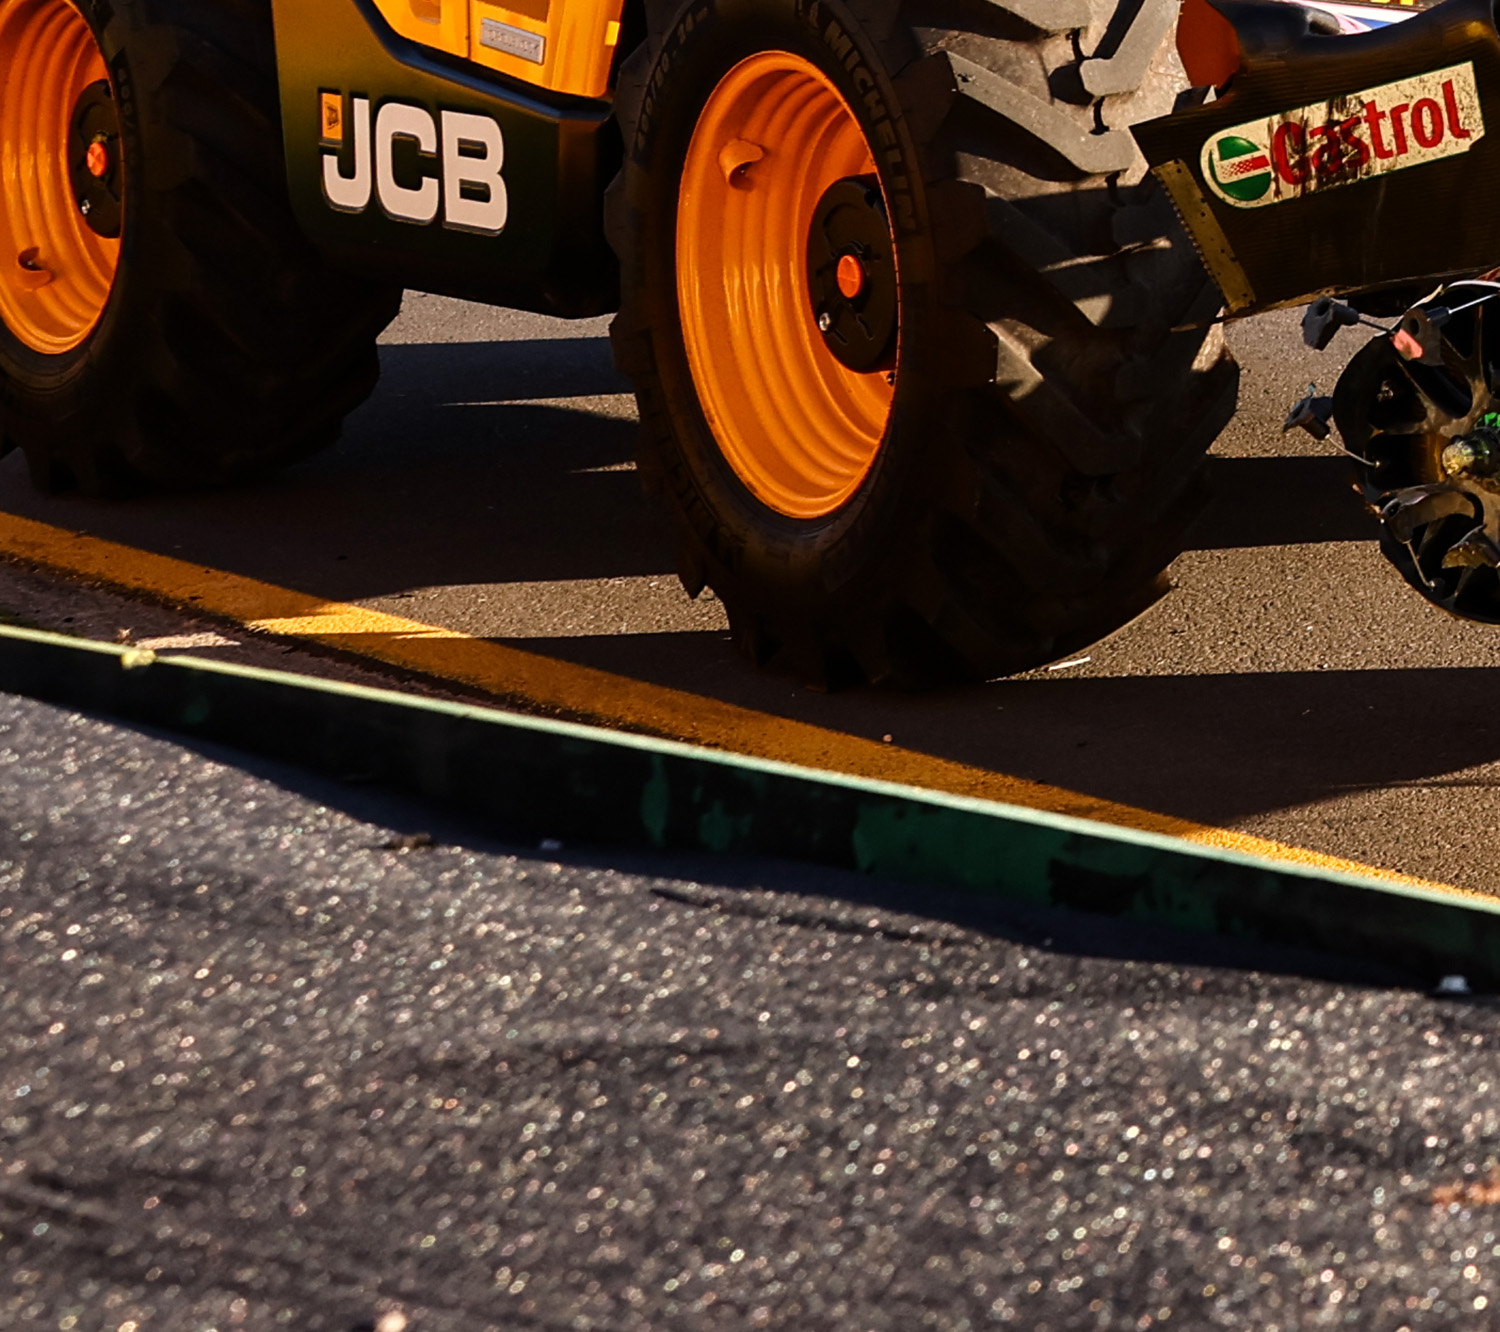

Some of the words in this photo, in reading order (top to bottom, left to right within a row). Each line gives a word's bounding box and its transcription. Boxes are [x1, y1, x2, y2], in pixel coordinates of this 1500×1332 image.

[322, 97, 508, 233] JCB
[823, 18, 917, 233] MICHELIN
[1272, 79, 1471, 186] Castrol
